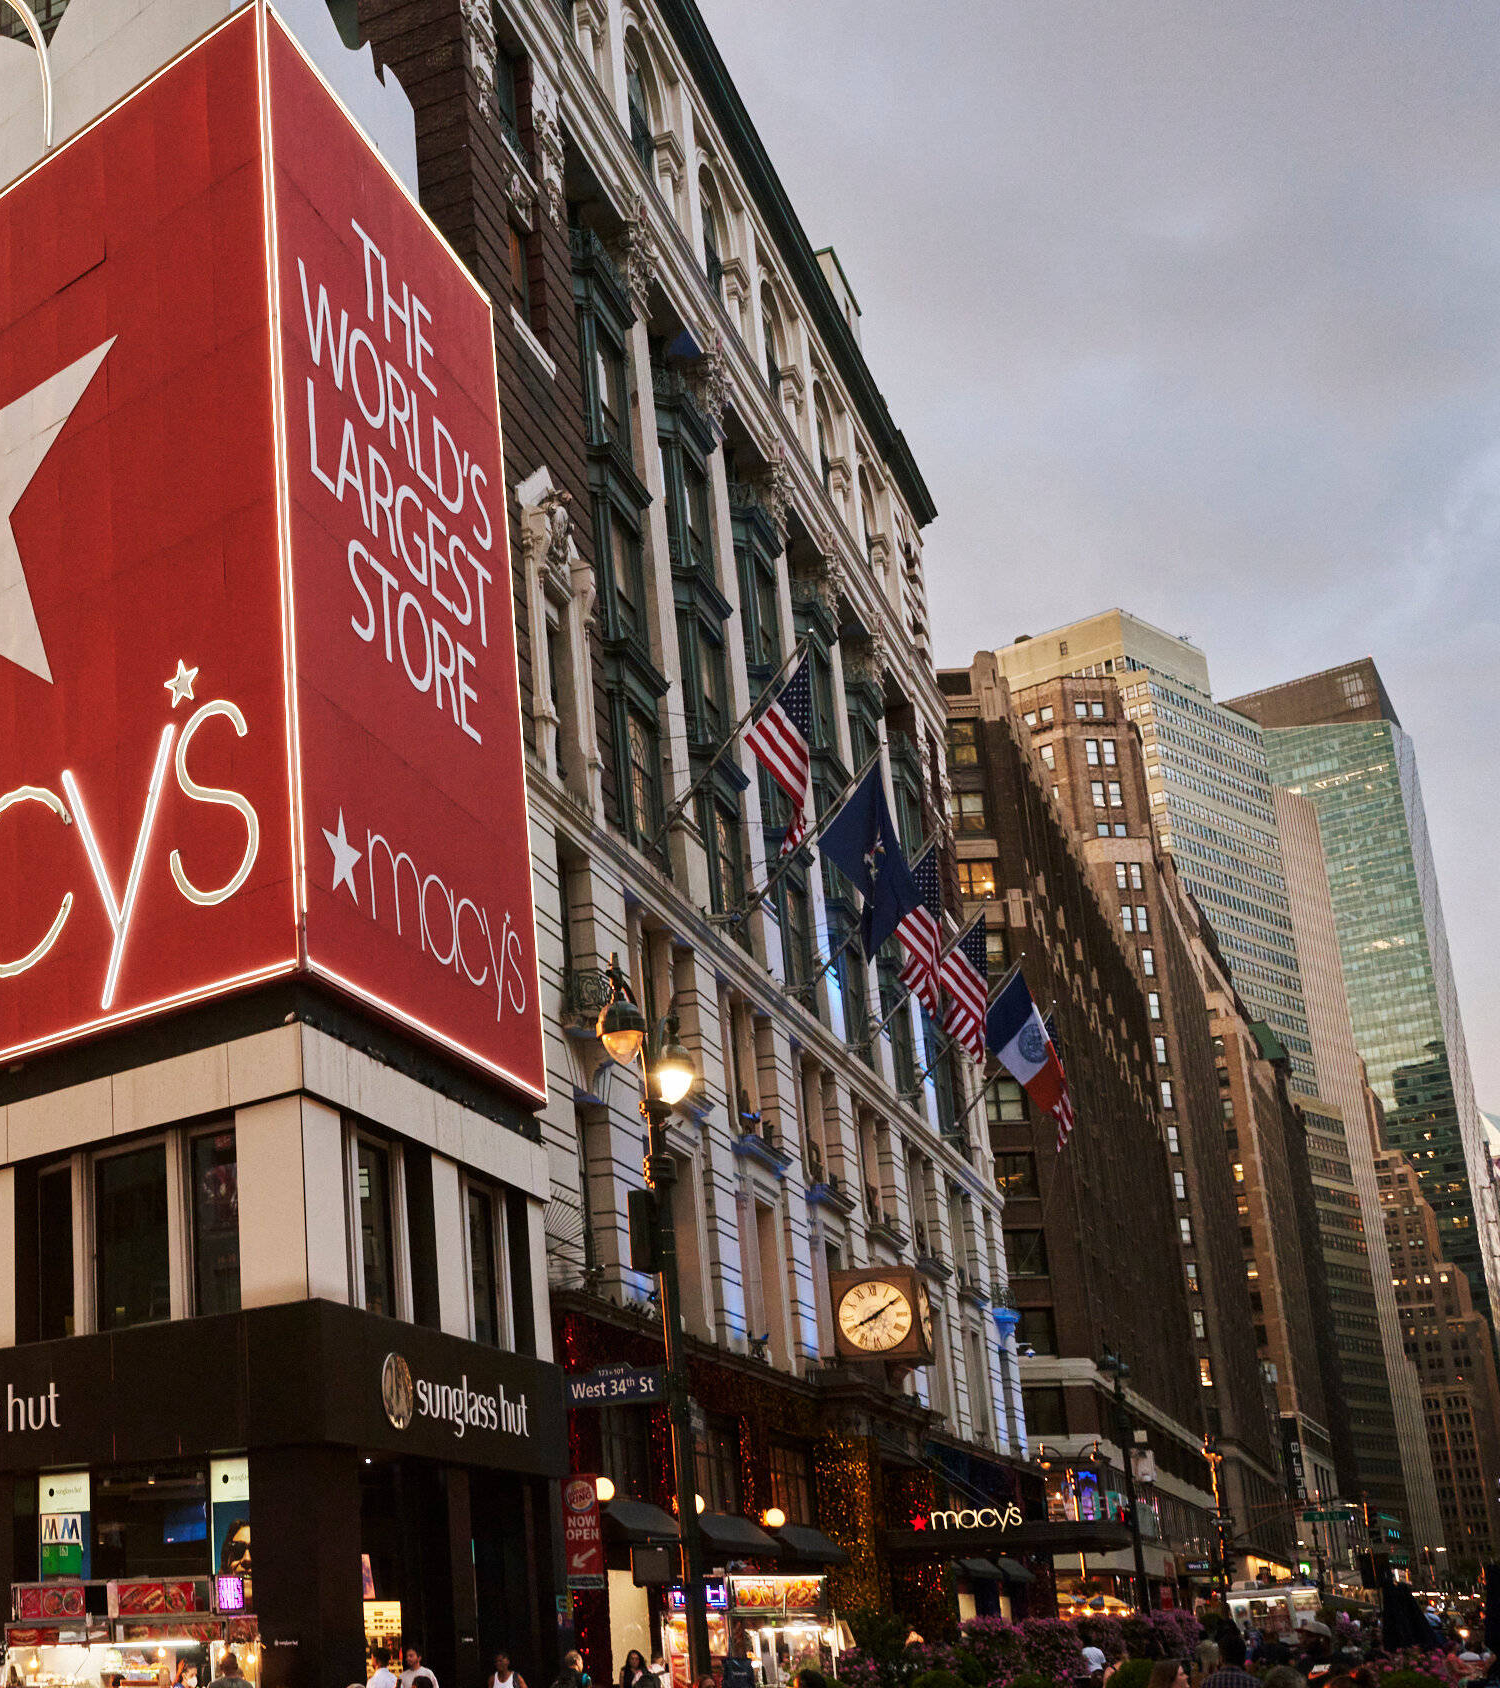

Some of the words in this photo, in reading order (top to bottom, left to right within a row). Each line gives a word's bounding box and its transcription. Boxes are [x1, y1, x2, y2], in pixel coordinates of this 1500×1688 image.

[351, 217, 438, 398] THE
[298, 256, 493, 551] WORLD'S
[306, 376, 493, 649] LARGEST
[347, 538, 482, 745] STORE
[366, 828, 526, 1023] macy's
[6, 1382, 62, 1433] hut
[416, 1374, 498, 1438] sunglass
[499, 1384, 530, 1438] hut
[571, 1382, 607, 1399] West
[610, 1377, 635, 1395] 34th
[639, 1376, 655, 1393] St
[566, 1529, 600, 1541] OPEN
[567, 1515, 597, 1528] NOW
[930, 1501, 1023, 1533] macy's
